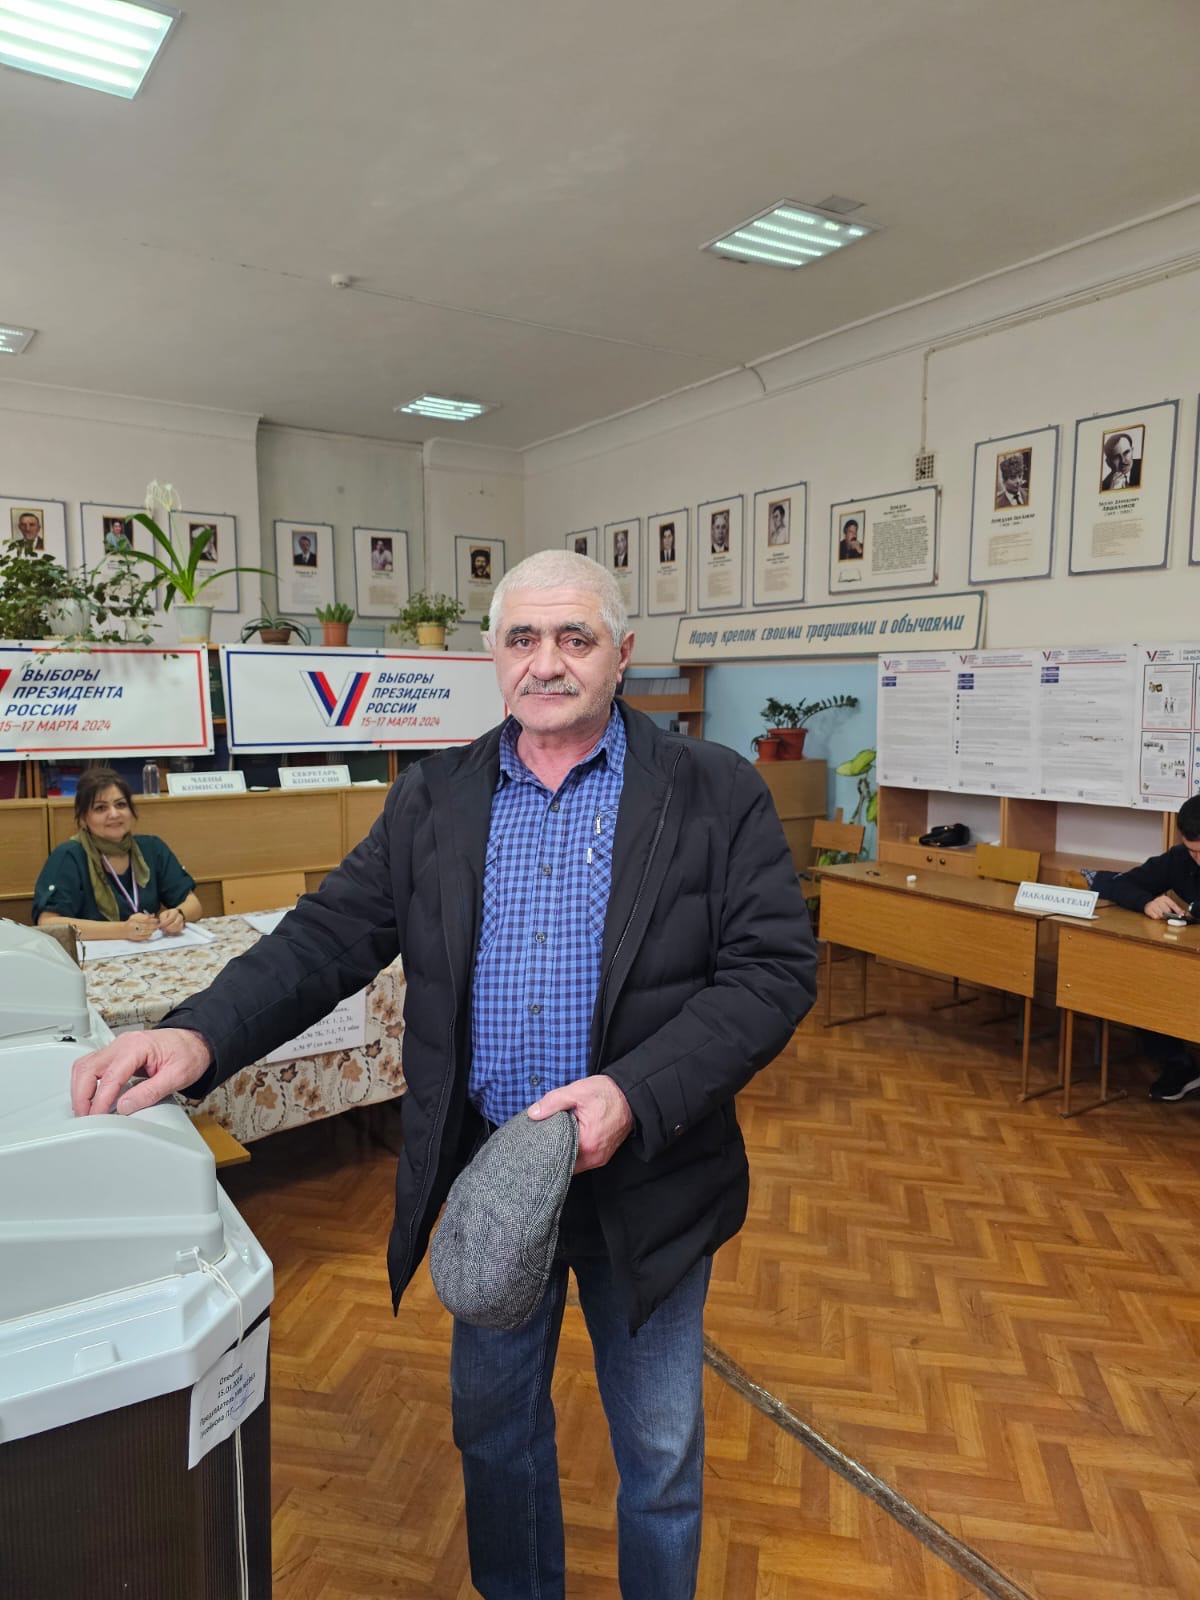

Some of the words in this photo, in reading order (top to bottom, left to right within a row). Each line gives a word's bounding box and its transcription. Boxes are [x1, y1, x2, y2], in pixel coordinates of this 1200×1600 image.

[689, 629, 718, 648] Народ
[721, 627, 757, 646] крепок
[761, 624, 803, 641] своими
[806, 620, 876, 643] традициями
[879, 619, 888, 634] и
[890, 613, 965, 634] обычаями
[22, 669, 101, 681] ВЫБОРЫ
[378, 672, 434, 683] ВЫБОРЫ
[12, 686, 124, 701] ПРЕЗИДЕНТА
[371, 687, 451, 700] ПРЕЗИДЕНТА
[4, 703, 77, 716] РОССИИ
[365, 702, 417, 714] РОССИИ
[36, 720, 79, 732] МАРТА
[81, 720, 112, 732] 2024
[387, 717, 417, 727] МАРТА
[419, 717, 440, 727] 2024
[292, 769, 338, 777] СЕКРЕТАРЬ
[190, 775, 222, 784] ЧЛЕНЫ
[292, 776, 340, 785] КОМИССИИ
[182, 783, 234, 792] КОМИССИИ
[1021, 890, 1091, 908] НАБЛЮДАТЕЛИ
